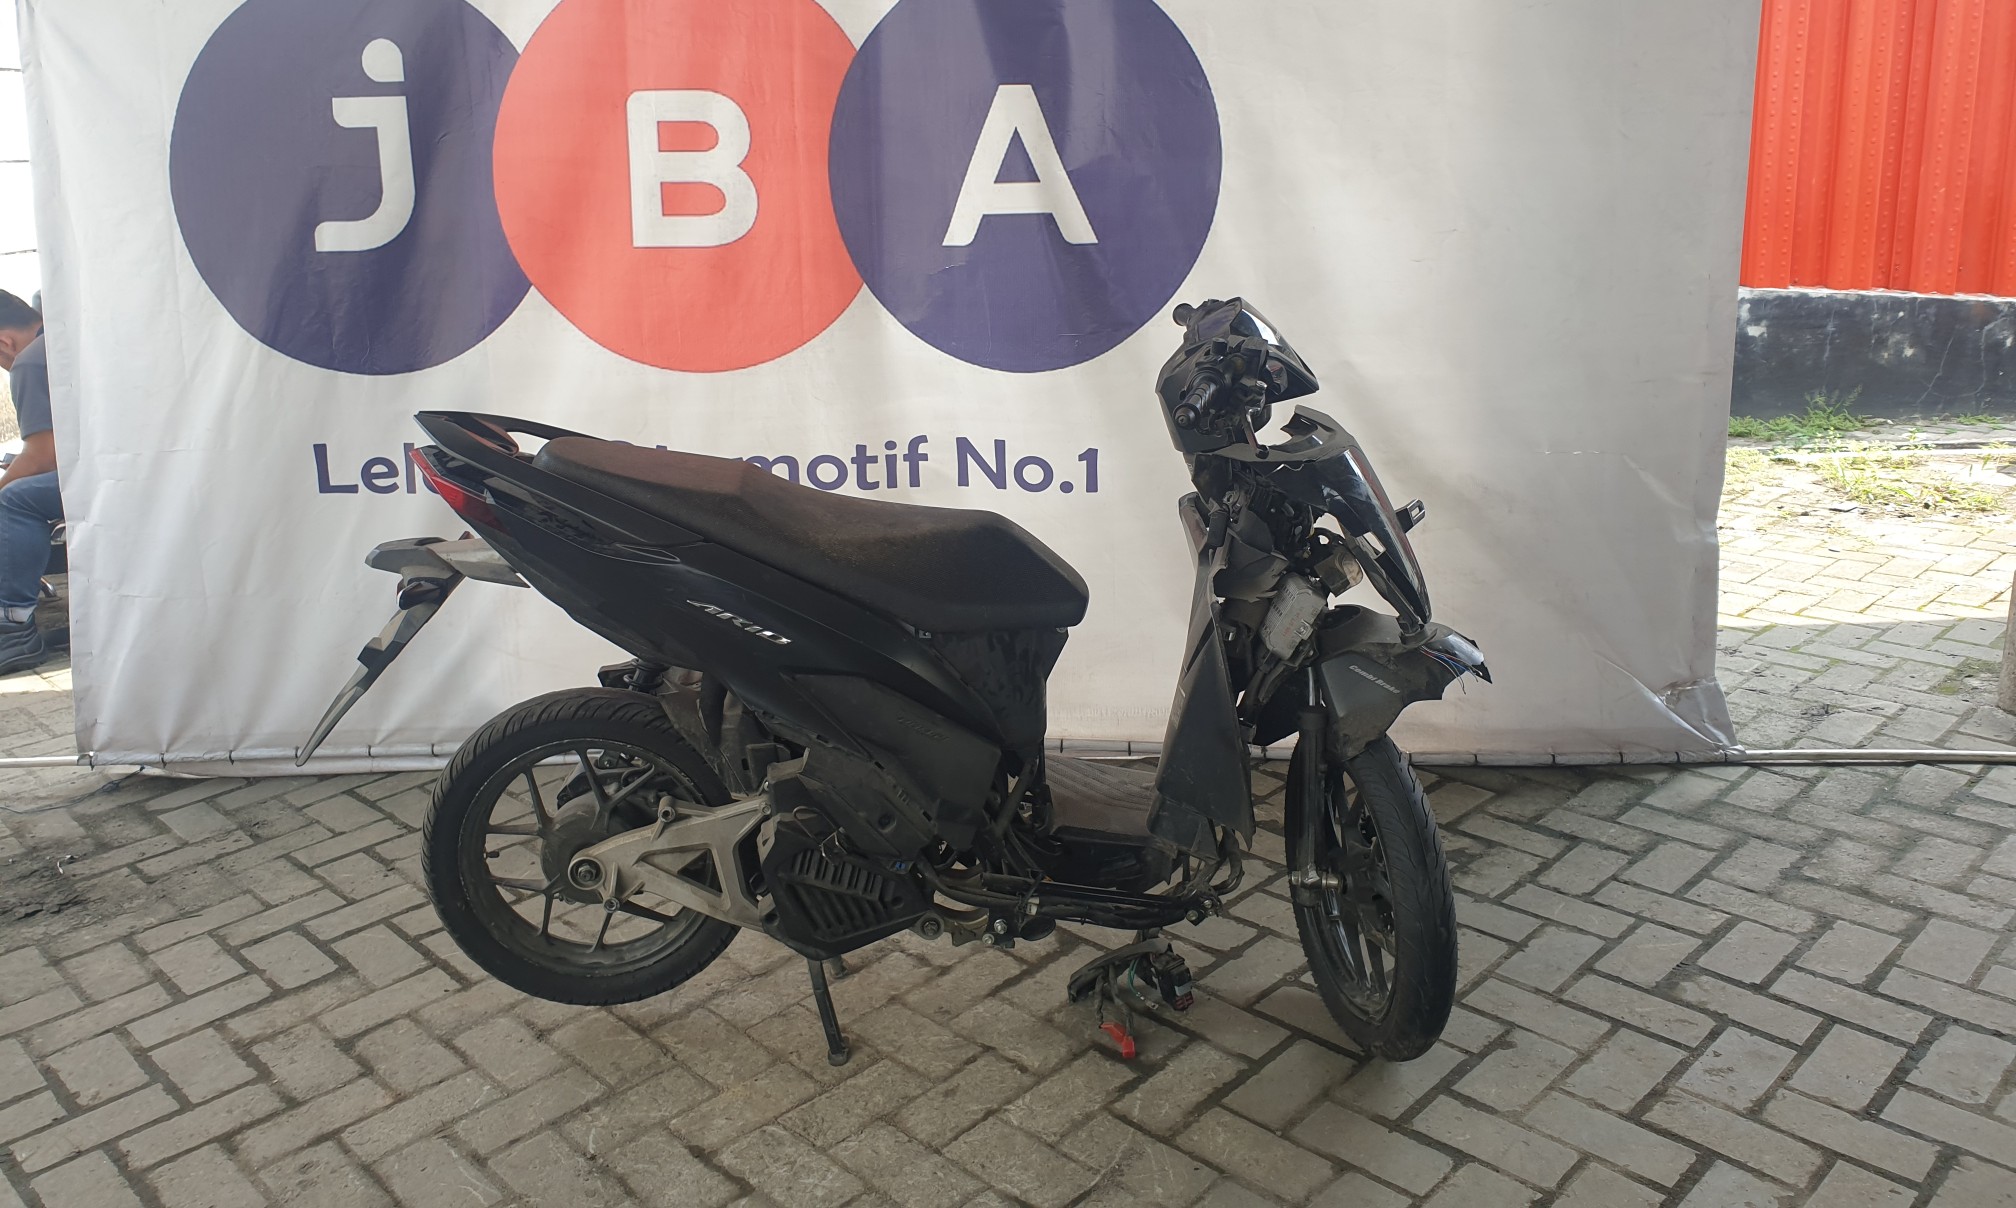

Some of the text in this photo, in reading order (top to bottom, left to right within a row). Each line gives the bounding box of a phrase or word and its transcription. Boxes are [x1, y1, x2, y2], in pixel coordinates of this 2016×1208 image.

[609, 435, 929, 491] motif
[955, 437, 1099, 494] No.1
[1349, 665, 1400, 694] Combi Brake
